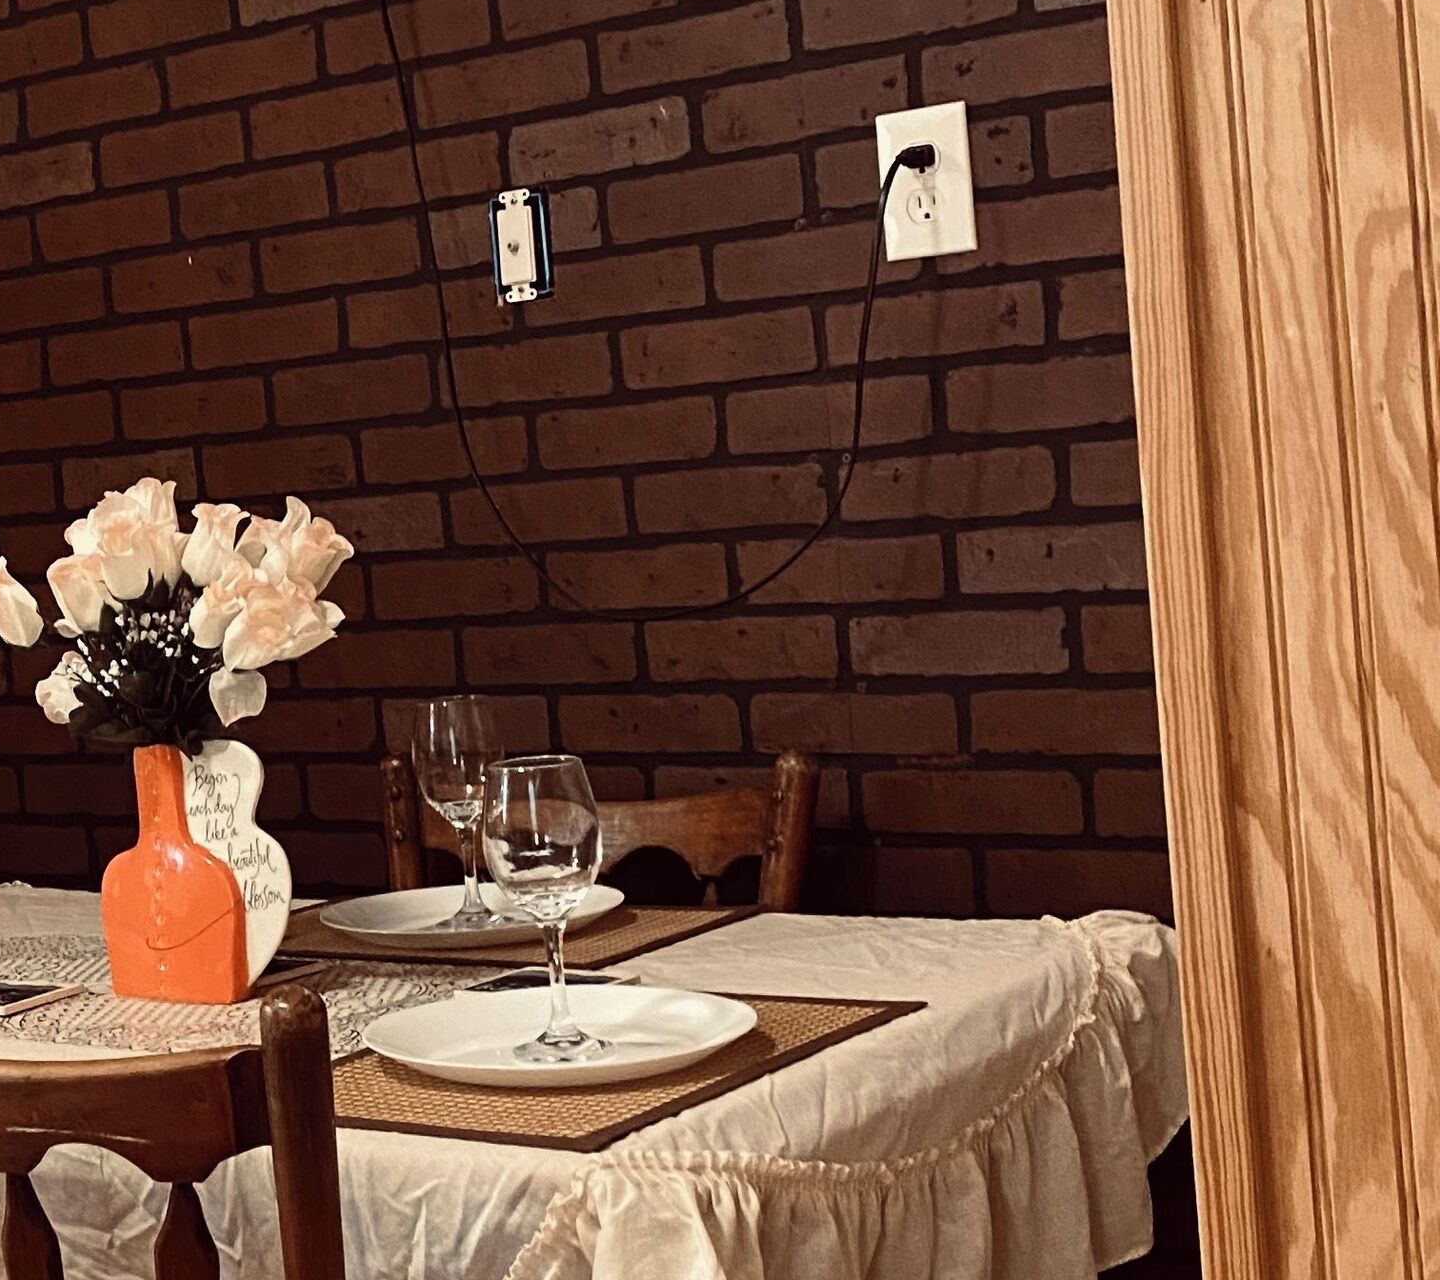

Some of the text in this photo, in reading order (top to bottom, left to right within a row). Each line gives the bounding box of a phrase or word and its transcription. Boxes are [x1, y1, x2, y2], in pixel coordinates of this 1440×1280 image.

[188, 765, 228, 798] Begin
[214, 784, 238, 828] day
[204, 819, 239, 843] like a
[227, 837, 278, 880] beautiful
